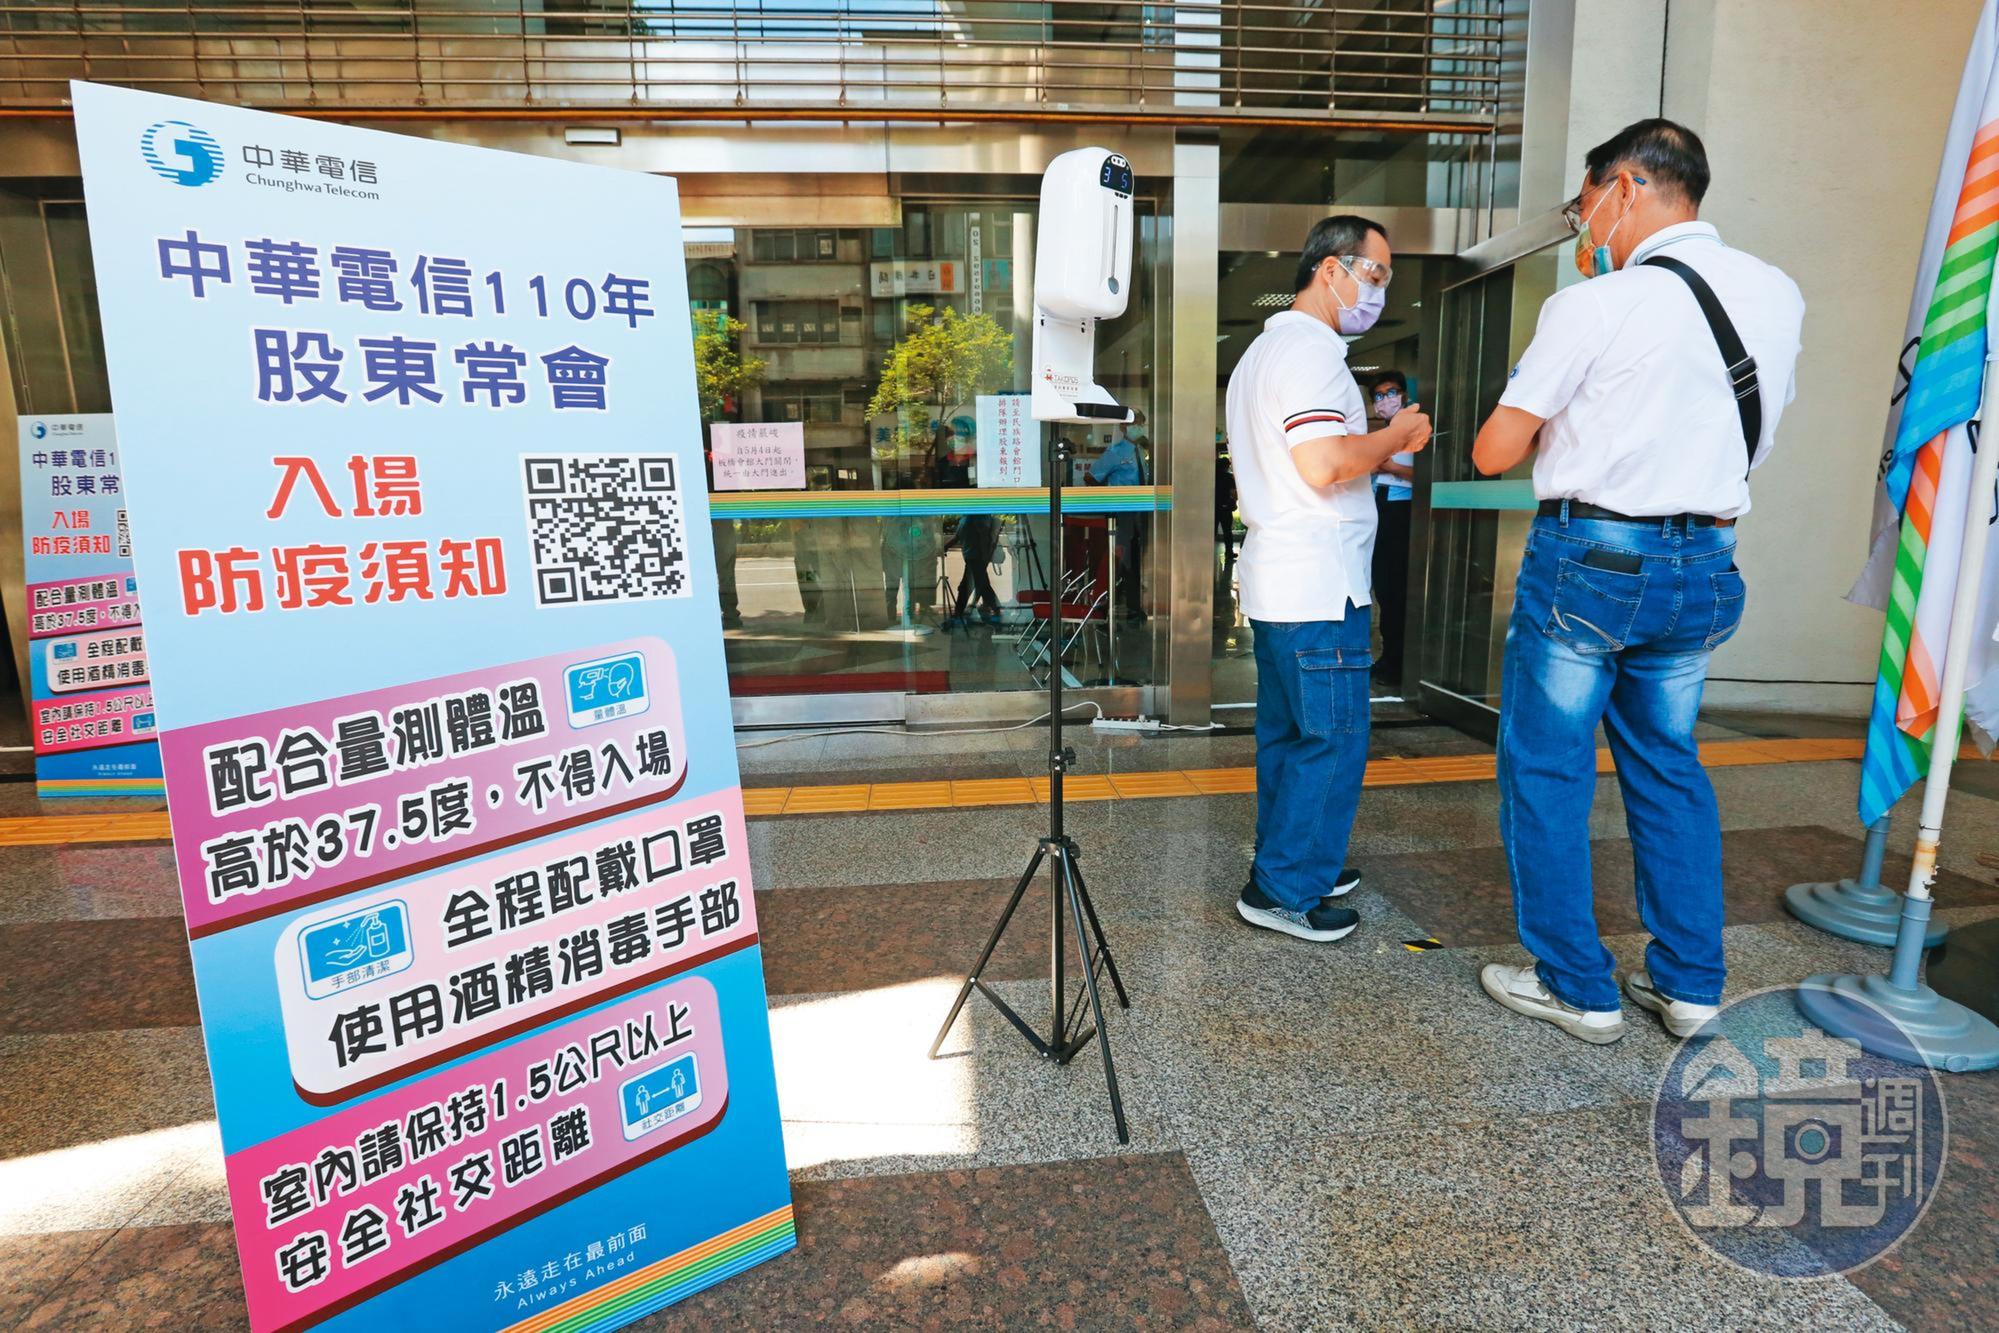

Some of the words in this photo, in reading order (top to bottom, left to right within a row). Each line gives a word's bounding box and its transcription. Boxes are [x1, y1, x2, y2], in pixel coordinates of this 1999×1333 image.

[242, 144, 378, 185] 中華電信
[246, 172, 322, 193] Chunghwa
[323, 183, 380, 200] Telecom
[157, 229, 655, 329] 中華電信110年
[253, 328, 610, 410] 股東常會
[52, 474, 120, 496] 股東常
[52, 510, 90, 528] 入場
[266, 455, 422, 521] 入場
[32, 535, 111, 555] 防疫須知
[178, 537, 507, 616] 防疫須知
[57, 660, 149, 685] 使用酒精消毒
[210, 681, 545, 811] 配合量測體溫
[443, 815, 727, 948] 全程配戴口罩
[328, 882, 740, 1068] 使用酒精消毒手部
[331, 959, 390, 989] 手部清潔
[263, 1001, 693, 1225] 室內請保持1.5公尺以上
[280, 1107, 593, 1289] 安全社交距離
[494, 1222, 647, 1302] 永遠走在最前面
[518, 1276, 577, 1310] Always
[585, 1251, 636, 1280] Ahead
